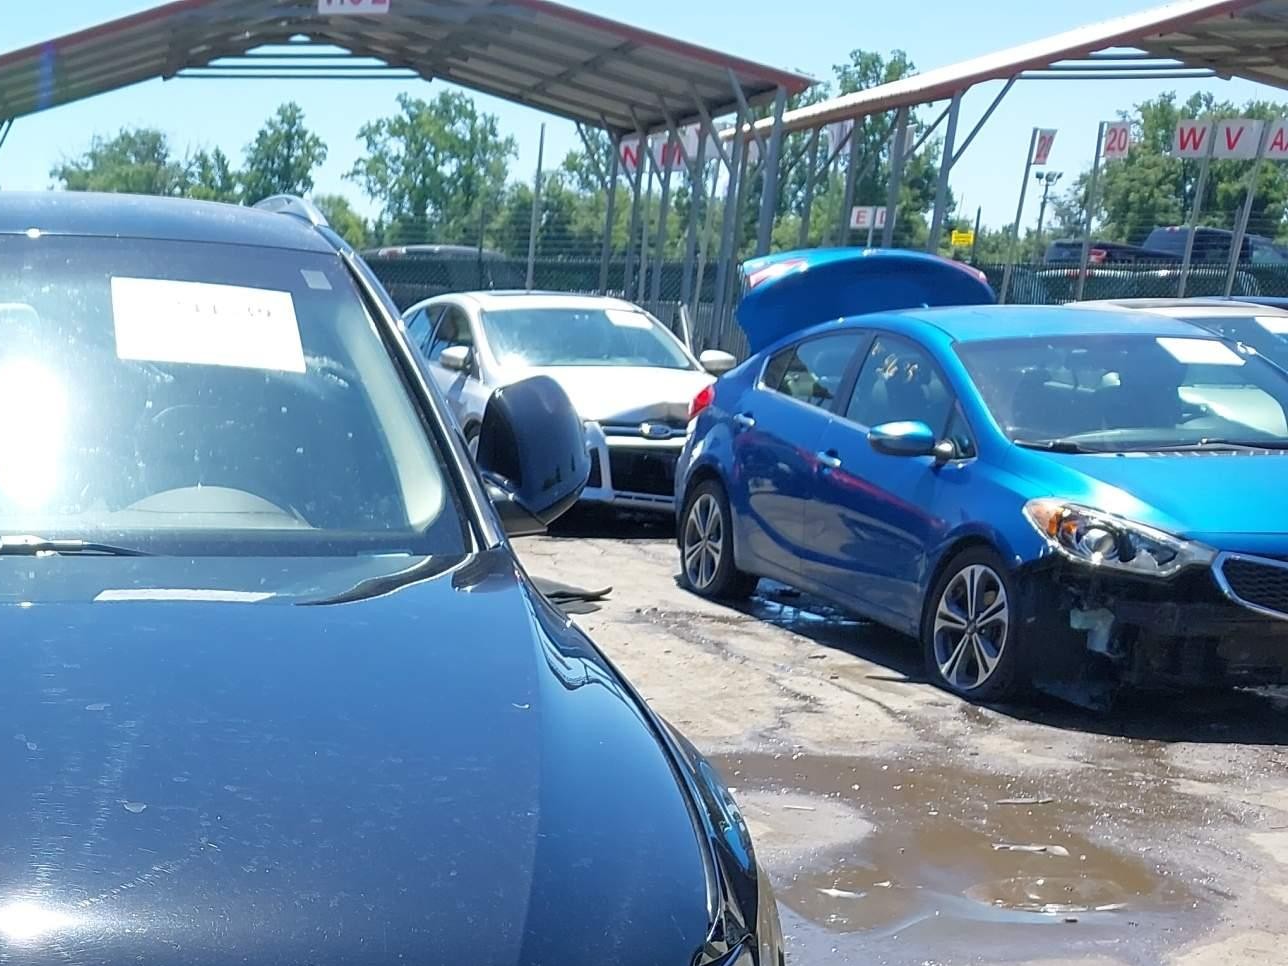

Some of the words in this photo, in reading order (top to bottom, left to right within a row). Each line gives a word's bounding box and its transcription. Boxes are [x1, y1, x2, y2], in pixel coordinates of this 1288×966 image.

[1106, 127, 1128, 152] 20
[1179, 127, 1206, 151] W
[1225, 126, 1245, 150] V
[855, 210, 867, 225] E
